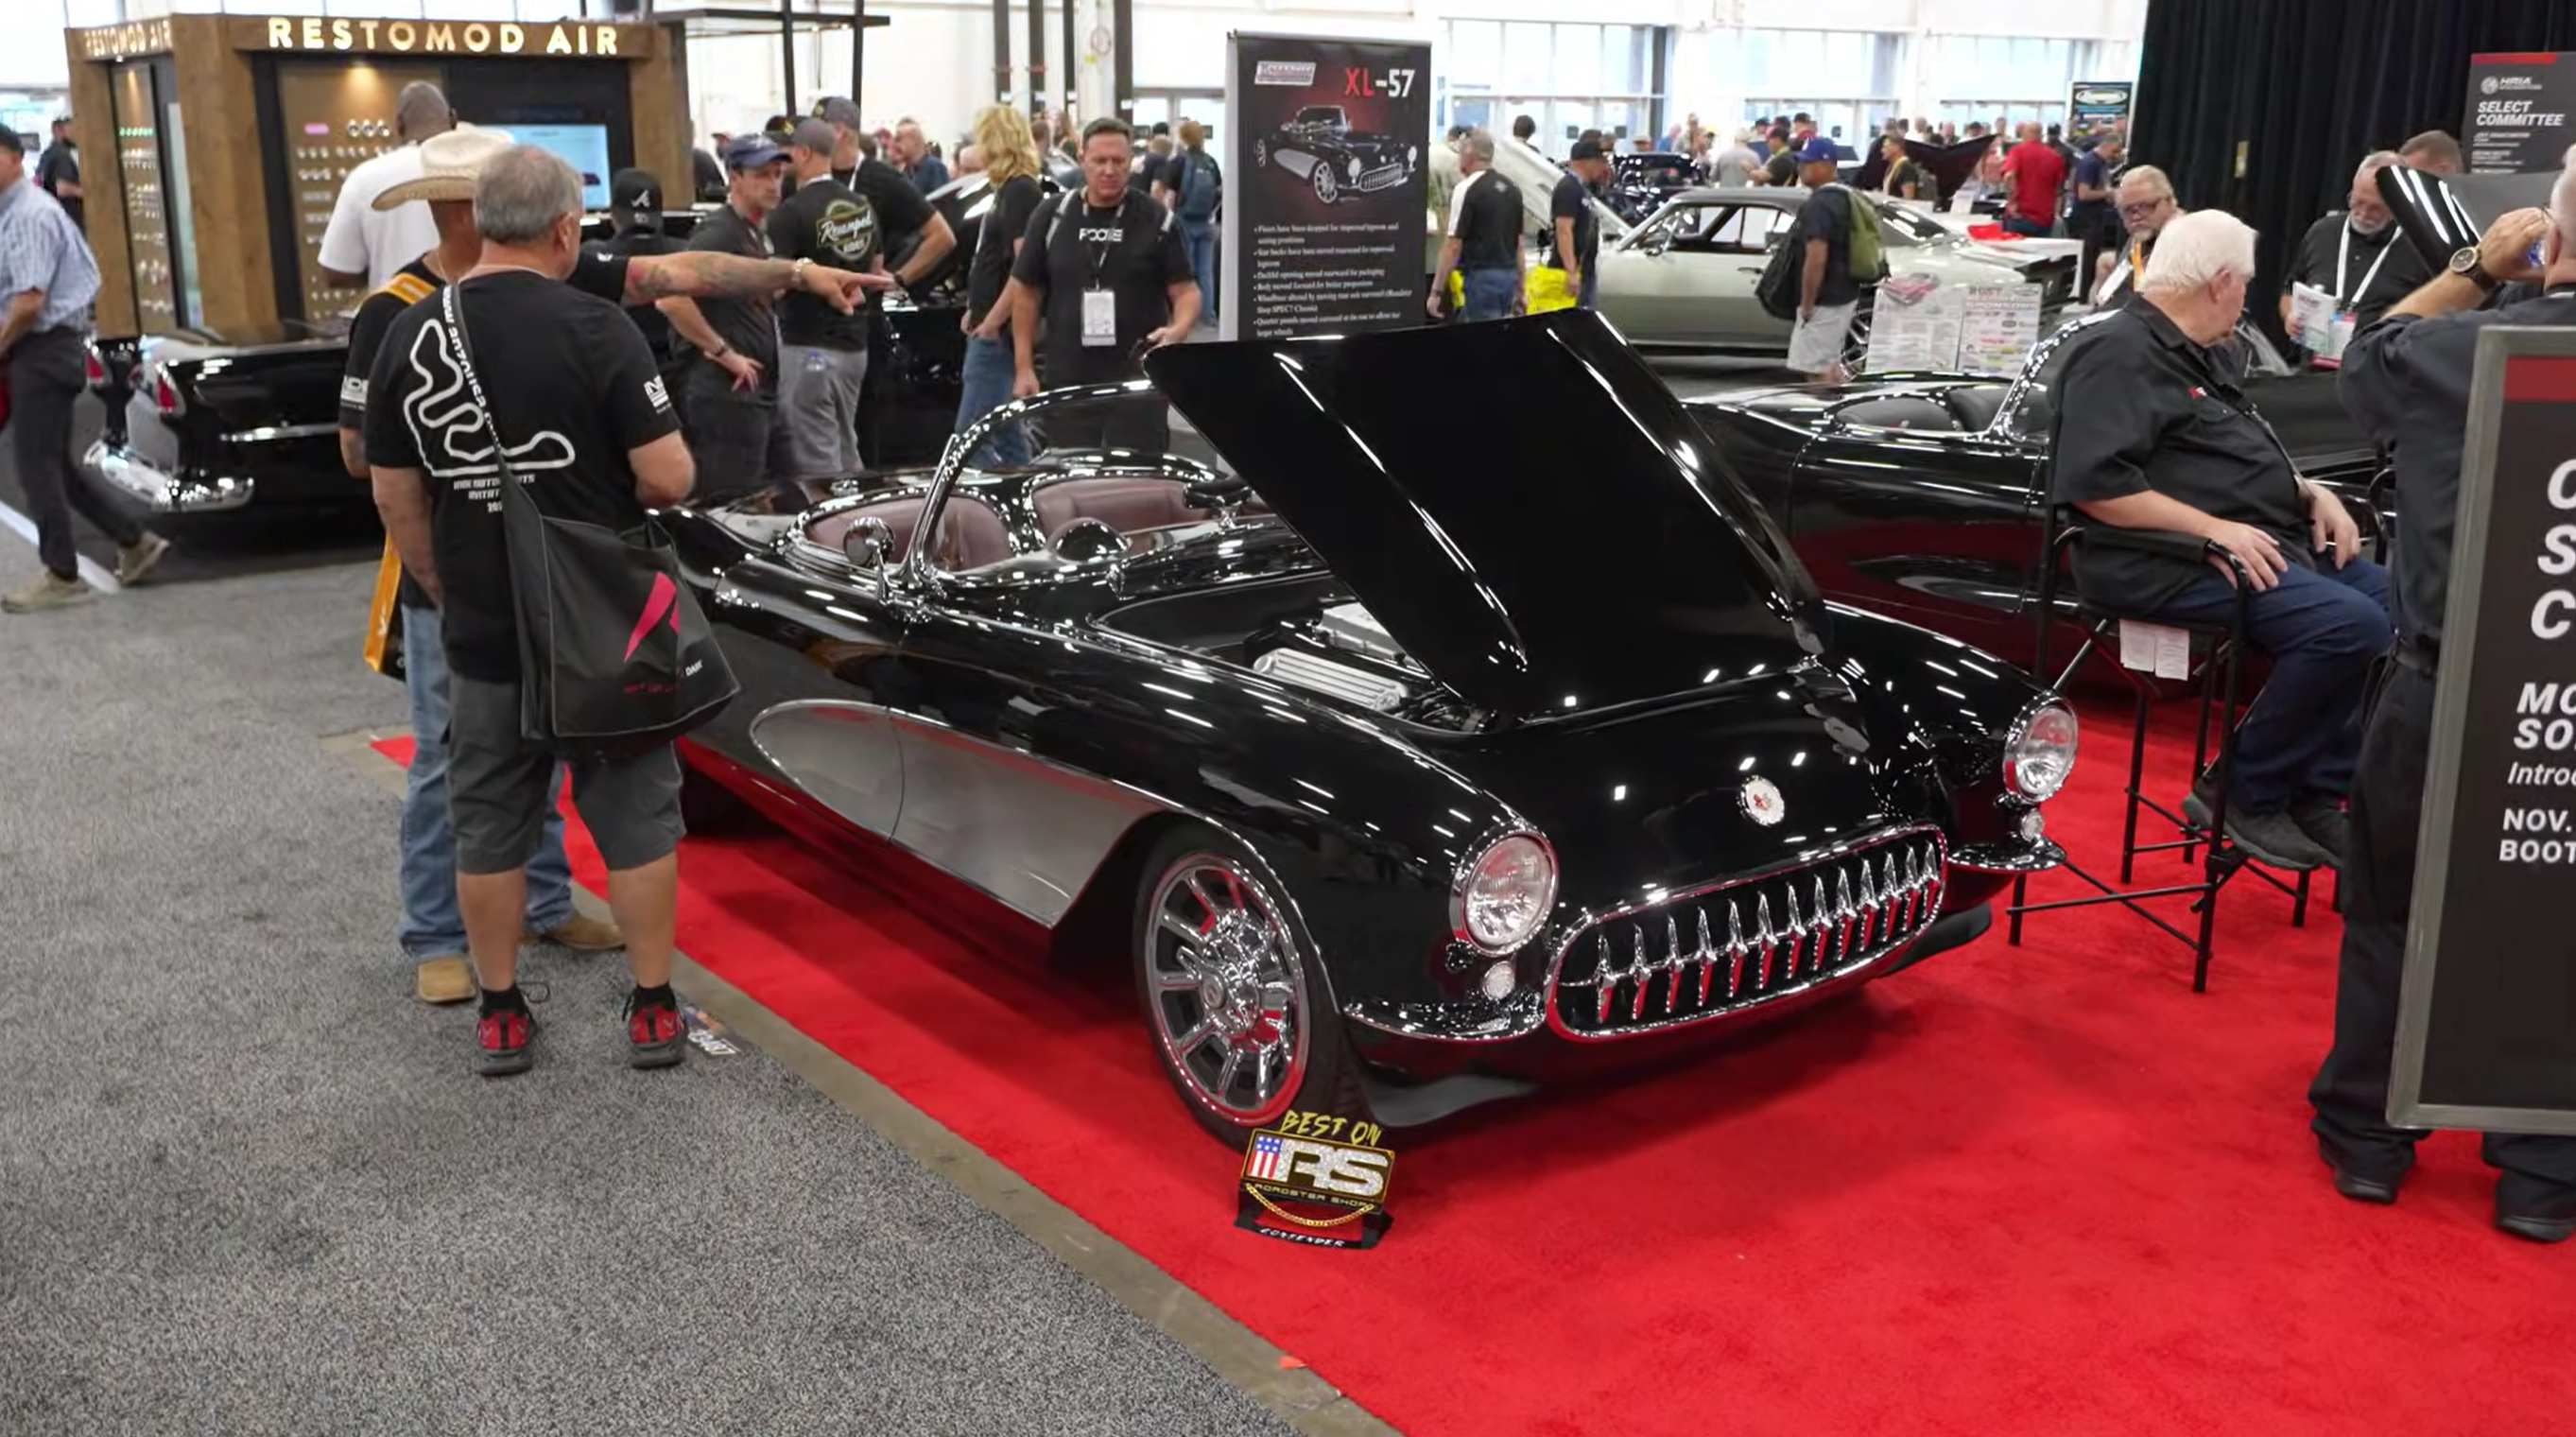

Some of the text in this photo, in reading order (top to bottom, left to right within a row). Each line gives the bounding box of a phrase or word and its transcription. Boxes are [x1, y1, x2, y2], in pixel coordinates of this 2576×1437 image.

[85, 25, 146, 56] RESTOMOD
[268, 17, 617, 55] RESTOMOD AIR
[1344, 67, 1416, 98] XL-57
[2499, 77, 2533, 85] HRIA
[2478, 100, 2533, 113] SELECT
[2476, 113, 2566, 127] COMMITTEE
[1079, 228, 1123, 242] FOOE
[2502, 807, 2572, 833] NOV.
[1280, 1109, 1382, 1147] BEST ON
[1253, 1184, 1326, 1202] ROADSTER
